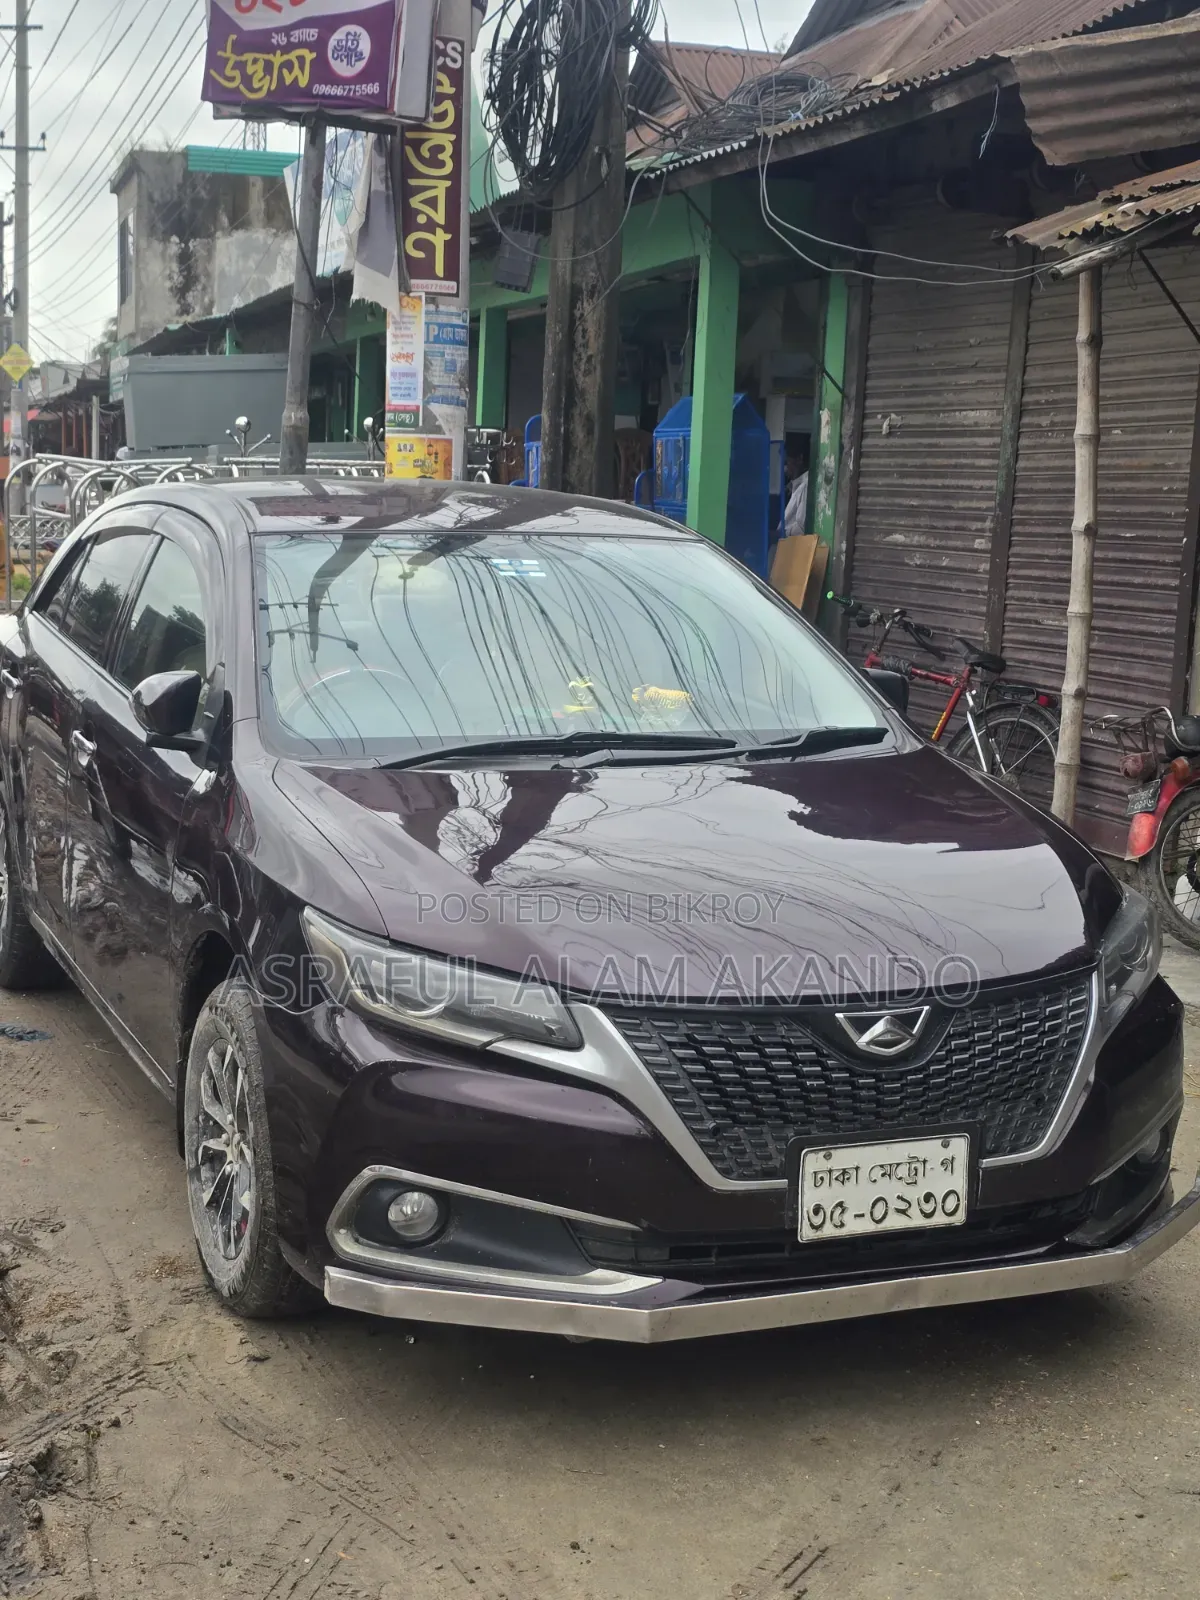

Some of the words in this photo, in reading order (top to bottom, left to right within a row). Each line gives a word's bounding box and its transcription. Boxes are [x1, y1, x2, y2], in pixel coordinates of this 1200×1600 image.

[332, 31, 362, 52] ভর্তি
[210, 34, 317, 99] উদ্ভাস
[312, 82, 380, 96] 09666775566
[812, 1165, 860, 1189] ঢাকা
[868, 1154, 929, 1186] মেট্রো
[940, 1153, 956, 1176] গ
[806, 1188, 962, 1232] ৩৫-০২৩০
